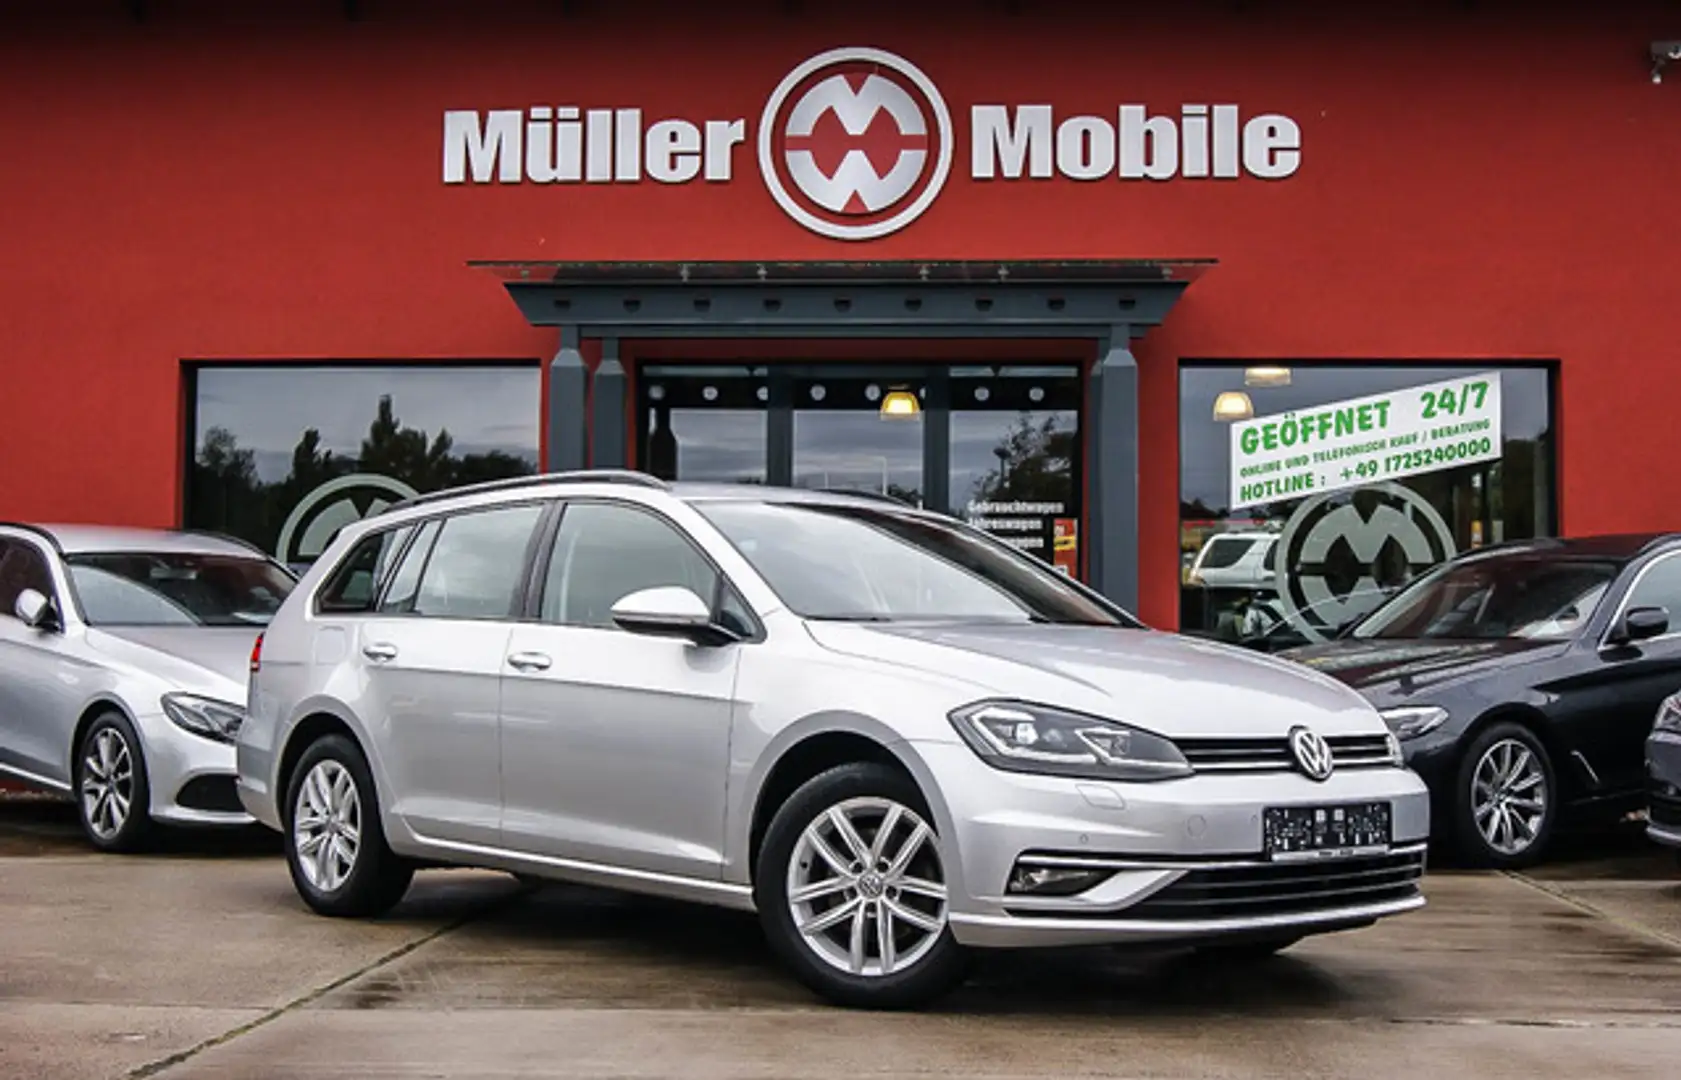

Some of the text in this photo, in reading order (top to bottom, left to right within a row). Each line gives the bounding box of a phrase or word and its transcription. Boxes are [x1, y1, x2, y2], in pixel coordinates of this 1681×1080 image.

[443, 107, 745, 184] Müller
[970, 104, 1301, 180] Mobile
[1240, 460, 1282, 477] ONLINE
[1285, 455, 1310, 469] UND
[1313, 438, 1386, 462] TELEFONISCH
[1390, 432, 1419, 448] KAUF
[1431, 419, 1490, 440] BERATUNG
[1241, 381, 1489, 455] GEÖFFNET 24/7
[1241, 473, 1315, 501] HOTLINE
[1384, 437, 1491, 472] 1725240000
